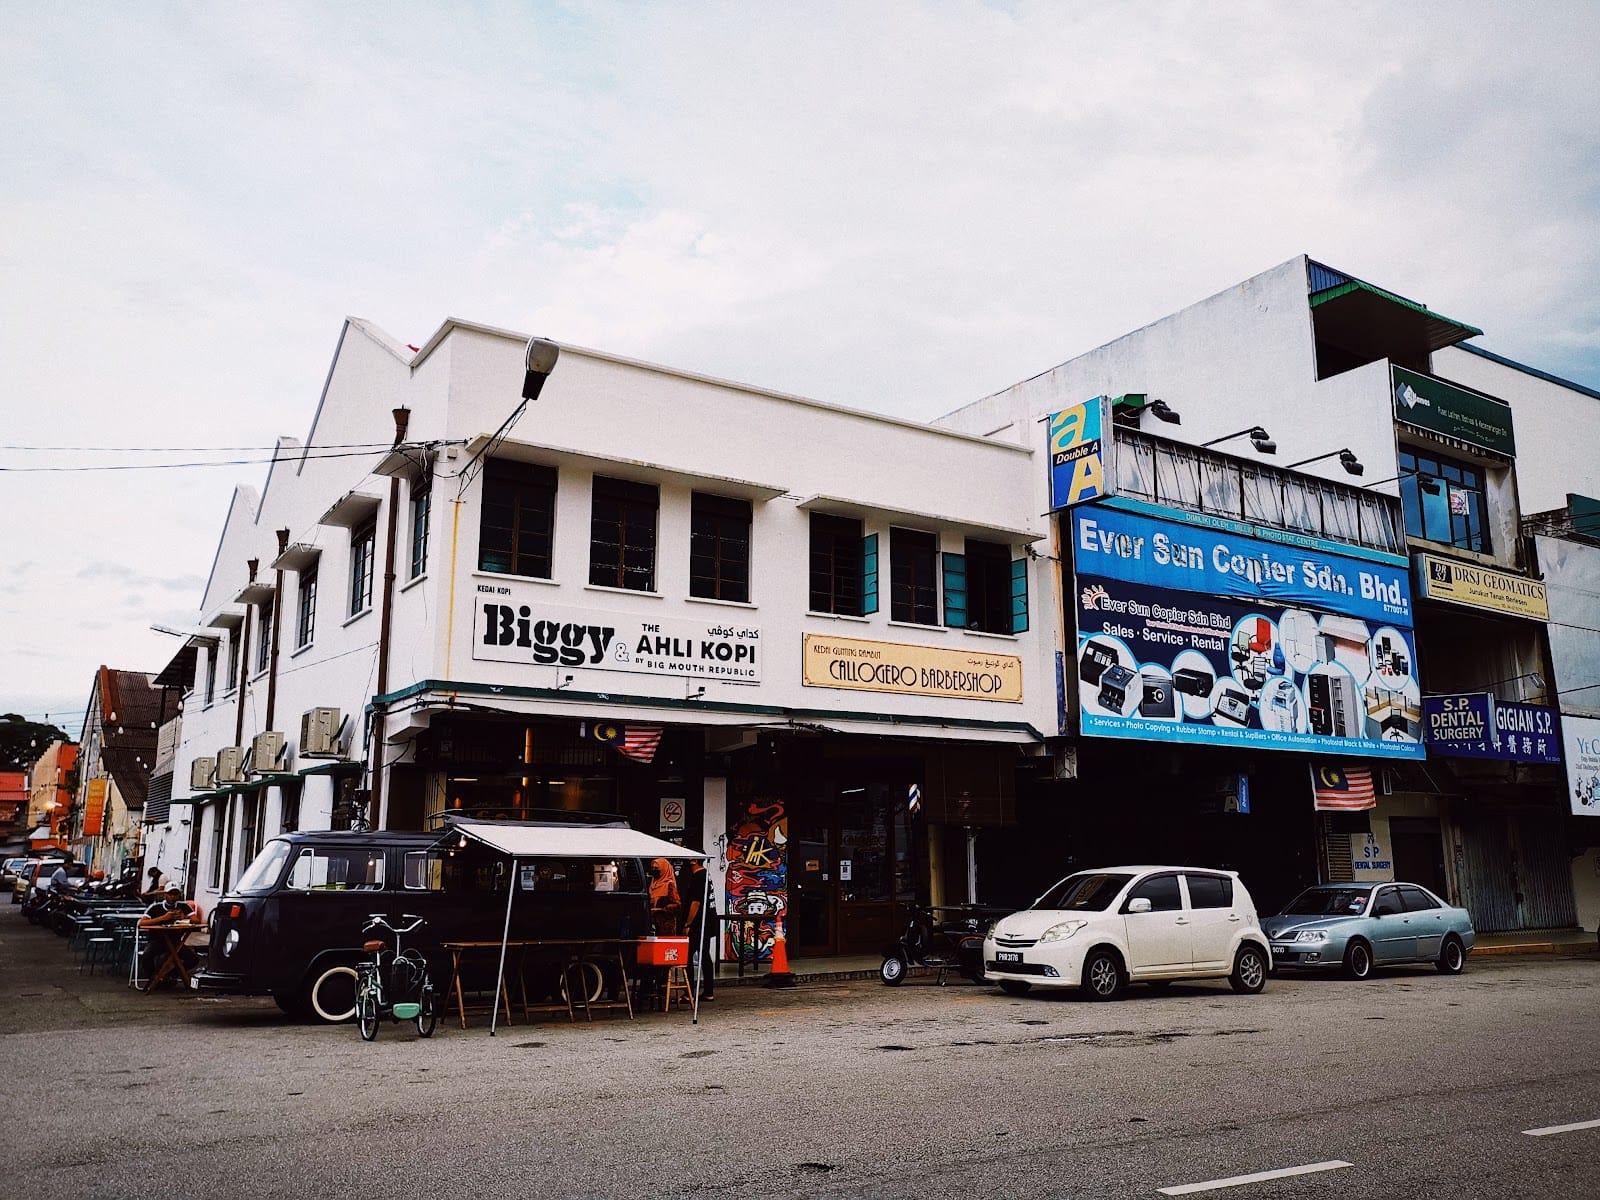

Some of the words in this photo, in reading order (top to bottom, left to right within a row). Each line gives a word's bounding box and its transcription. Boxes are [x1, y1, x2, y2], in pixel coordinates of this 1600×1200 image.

[1055, 447, 1089, 465] Double
[1090, 441, 1099, 453] A
[1212, 518, 1229, 530] OLEH
[1296, 536, 1319, 548] CENTRE
[1079, 518, 1145, 560] Ever
[1152, 532, 1204, 570] Sun
[1212, 544, 1296, 585] Copier
[1302, 560, 1354, 596] Sdn.
[1359, 571, 1408, 606] Bhd.
[477, 585, 495, 593] KEDAI
[1454, 566, 1480, 586] DRSJ
[1483, 573, 1544, 600] GEOMATICS
[1100, 596, 1127, 613] Ever
[1128, 600, 1151, 617] Sun
[1152, 604, 1187, 624] Copier
[1187, 610, 1209, 625] Sdn
[1209, 613, 1232, 629] Bhd
[483, 603, 615, 666] Biggy
[614, 643, 630, 662] &
[641, 624, 660, 632] THE
[1102, 621, 1135, 639] Sales
[1142, 627, 1184, 645] Service
[1191, 635, 1225, 651] Rental
[636, 635, 692, 658] AHLI
[701, 641, 755, 664] KOPI
[813, 645, 831, 655] KEDAI
[647, 661, 665, 669] BIG
[668, 662, 704, 673] MOUTH
[708, 666, 755, 677] REPUBLIC
[829, 659, 917, 687] CALLOGERO
[921, 667, 1002, 694] BARBERSHOP
[1443, 698, 1469, 711] S.P.
[1094, 717, 1121, 729] Services
[1125, 719, 1144, 731] Photo
[1144, 721, 1171, 734] Copying
[1175, 724, 1197, 735] Rubber
[1197, 726, 1217, 738] Stamp
[1270, 733, 1288, 742] Office
[1288, 734, 1318, 745] Automation
[1431, 711, 1485, 728] DENTAL
[1433, 726, 1484, 740] SURGERY
[1495, 706, 1534, 733] GIGIAN
[1536, 711, 1553, 735] S.P.
